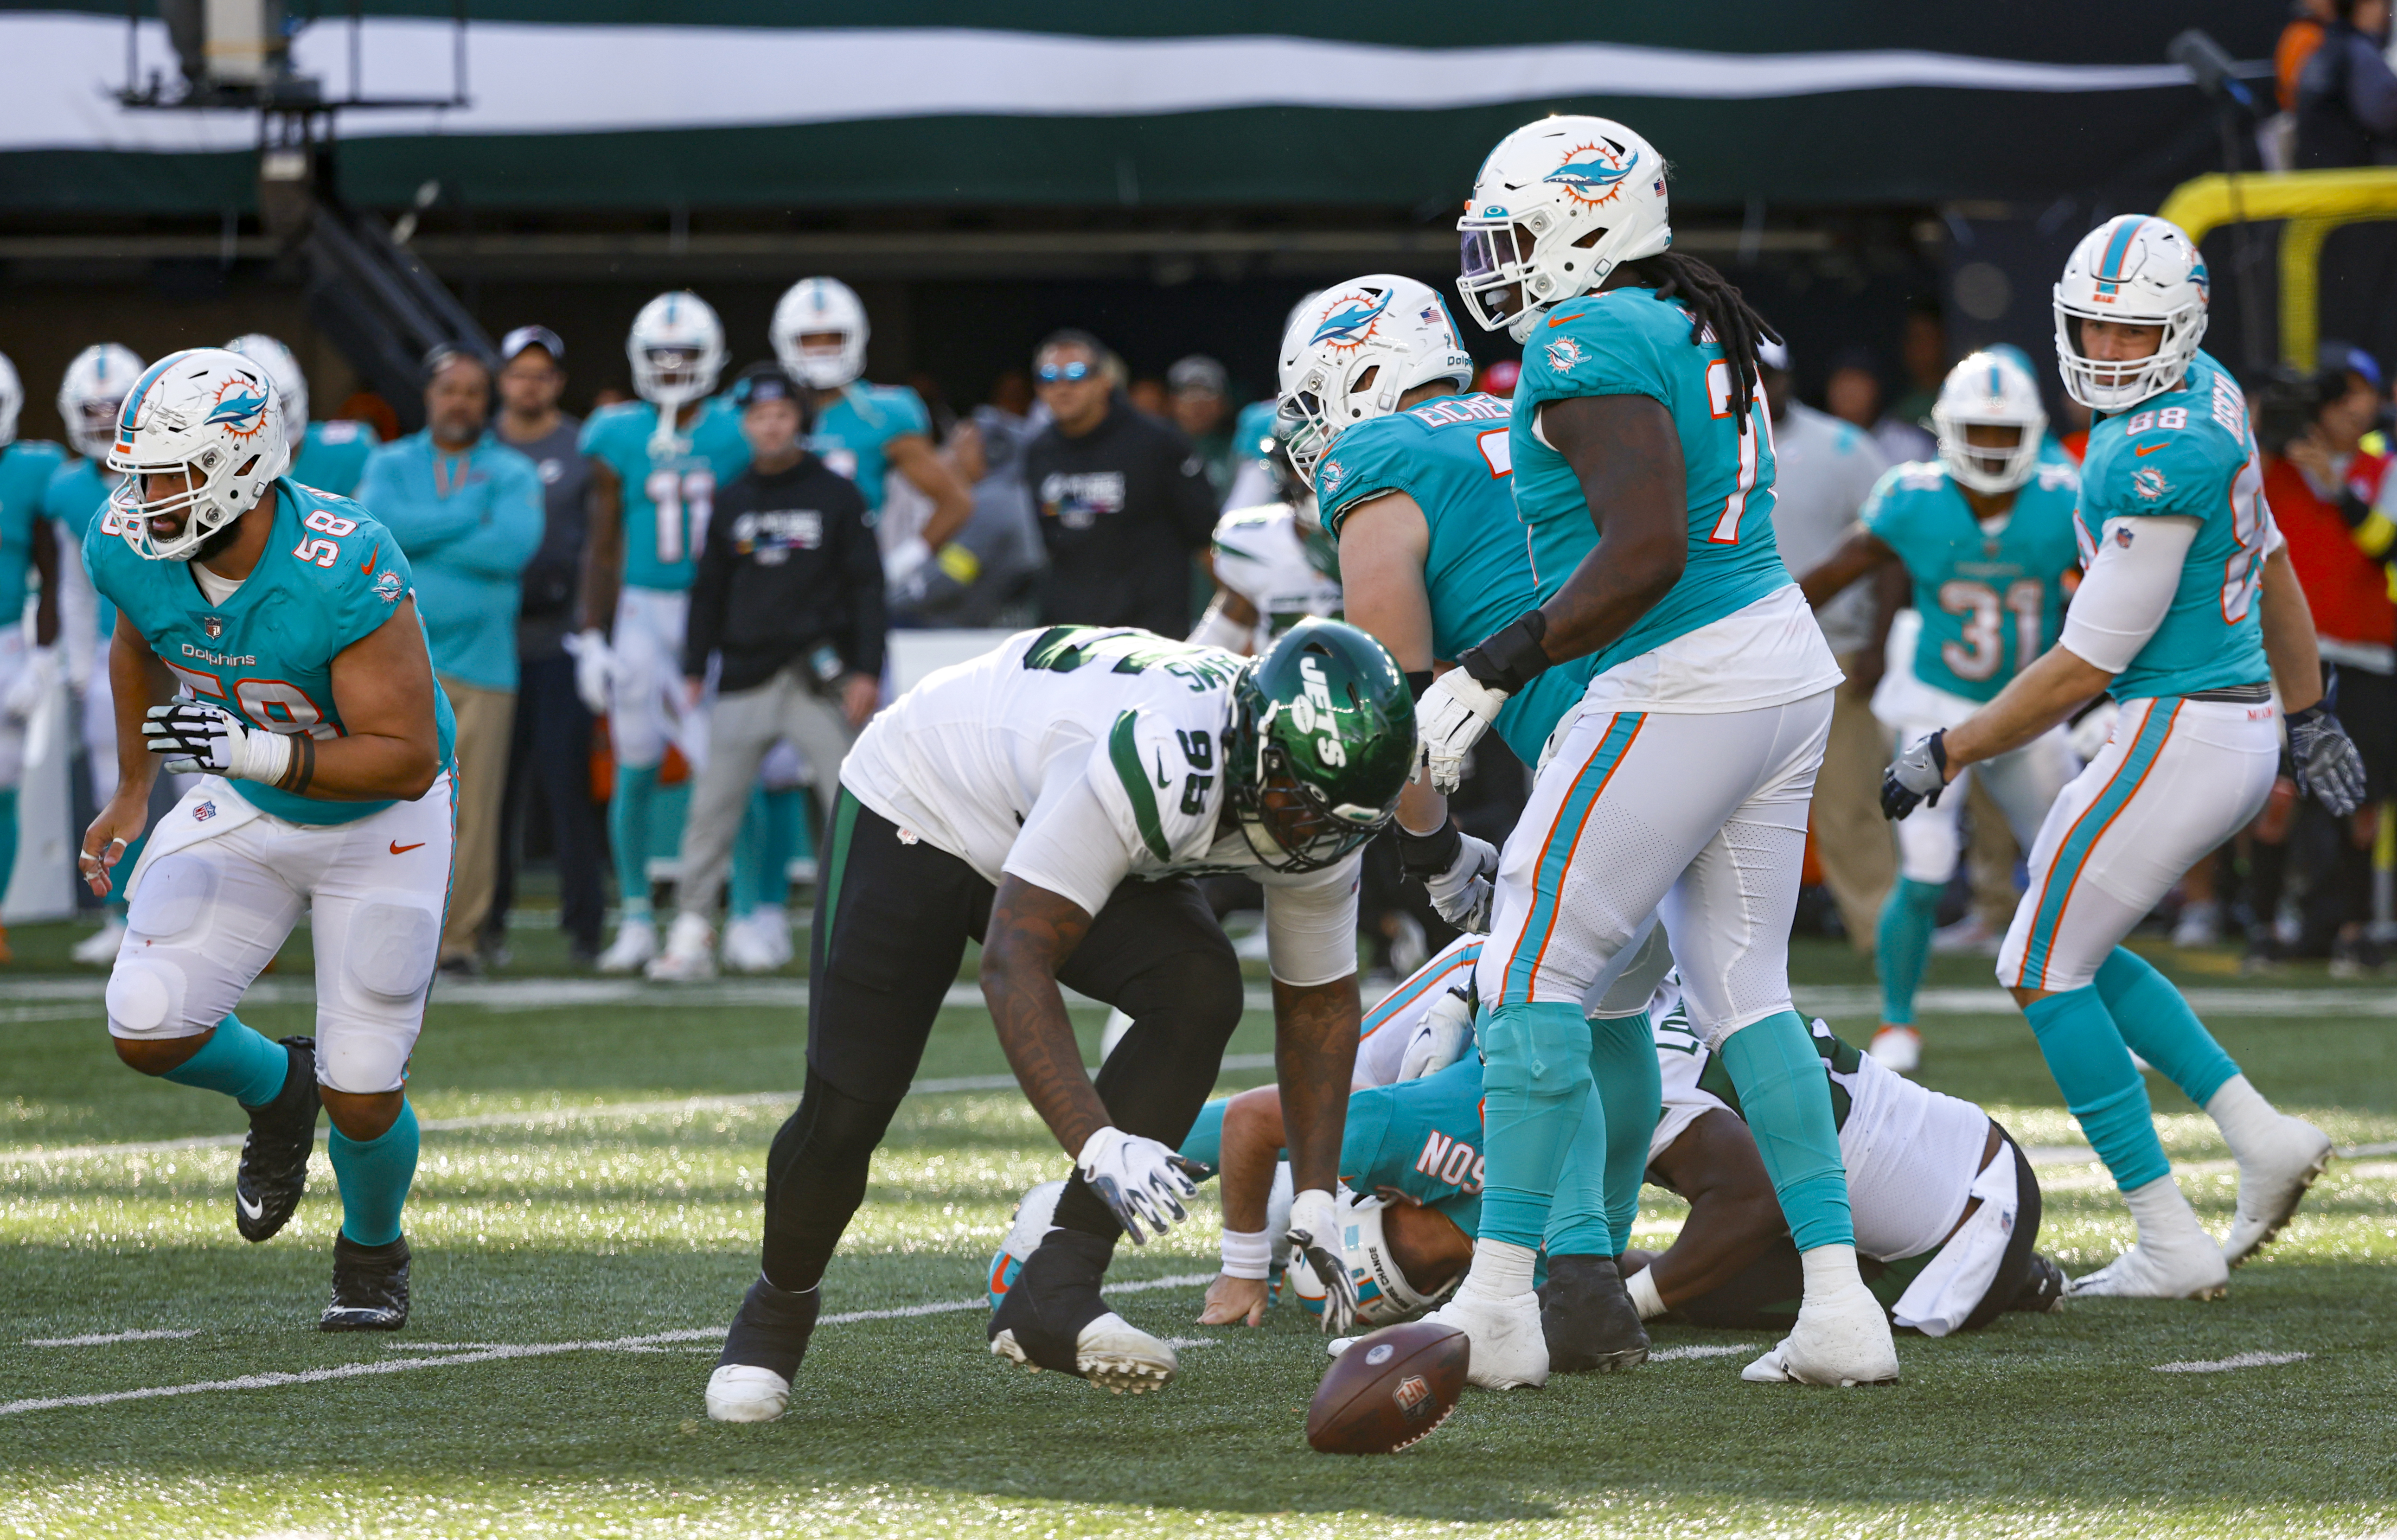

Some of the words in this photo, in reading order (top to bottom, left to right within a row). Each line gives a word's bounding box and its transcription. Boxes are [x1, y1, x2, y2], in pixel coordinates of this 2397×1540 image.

[2126, 407, 2188, 436] 88
[645, 469, 715, 563] 11
[291, 509, 358, 569] 58
[207, 625, 220, 636] NFL
[1939, 580, 2043, 684] 31
[182, 644, 256, 667] Dolphins
[1300, 657, 1346, 768] JETS
[1396, 1379, 1430, 1407] NFL
